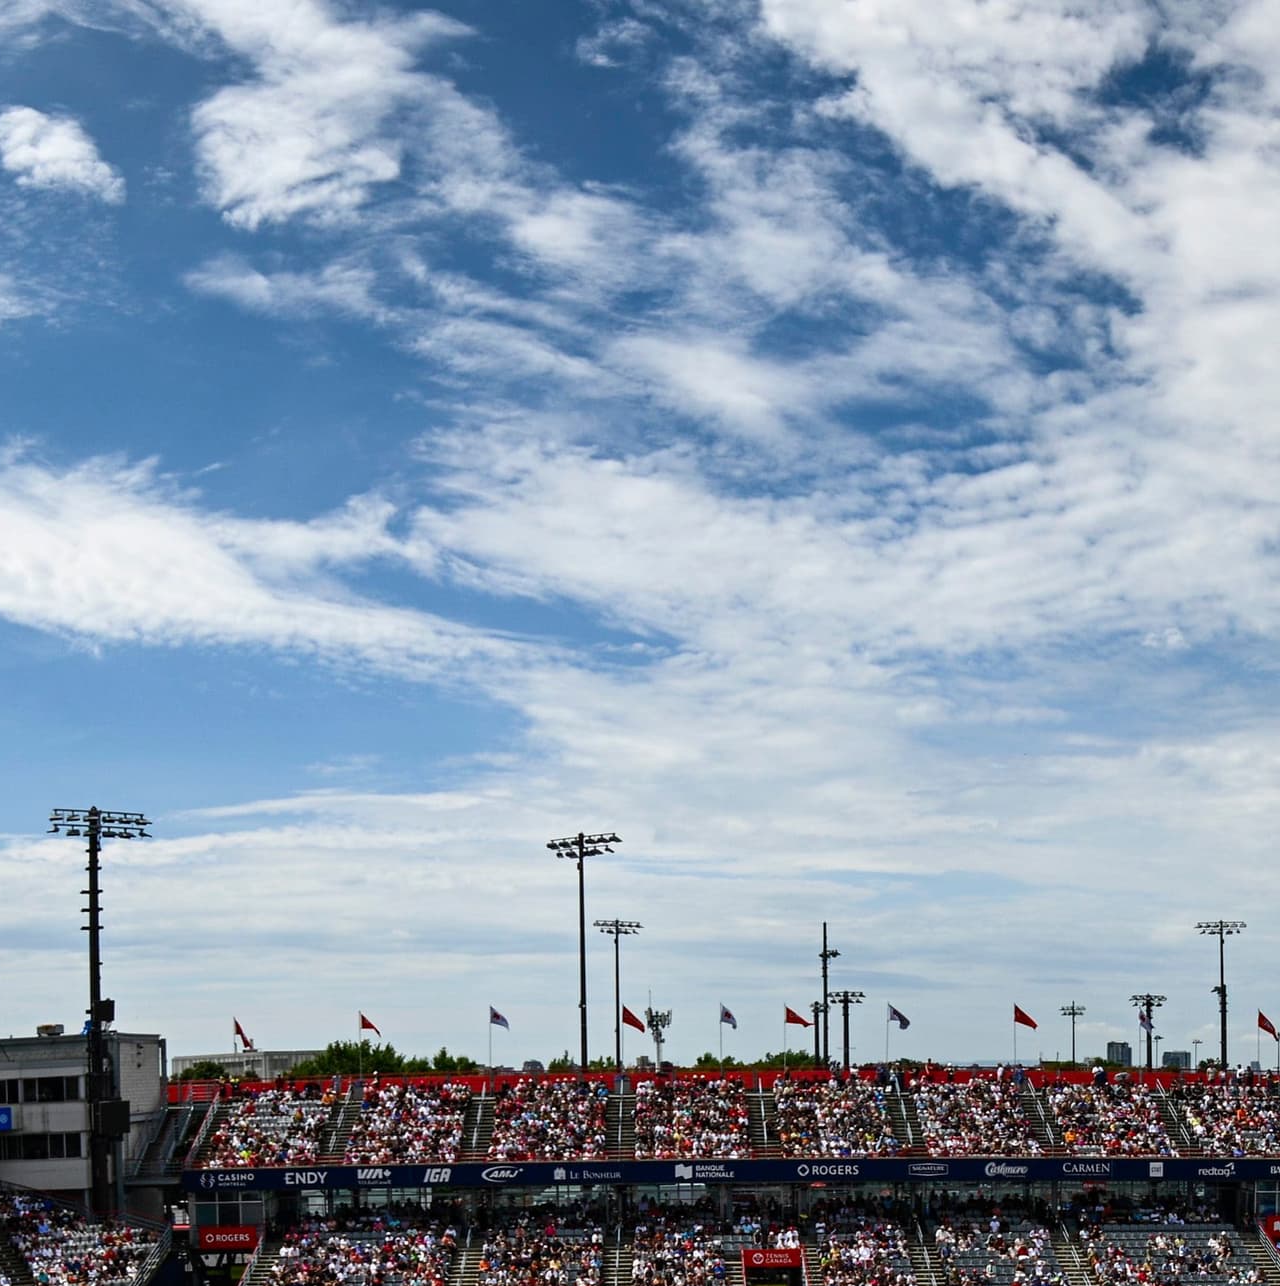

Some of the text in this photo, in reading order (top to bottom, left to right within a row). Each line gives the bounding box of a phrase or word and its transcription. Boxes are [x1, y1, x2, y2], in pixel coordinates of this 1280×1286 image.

[812, 1165, 860, 1176] ROGERS
[1062, 1162, 1111, 1173] CARMEN
[218, 1173, 255, 1182] CASINO
[284, 1172, 328, 1184] ENDY
[357, 1169, 384, 1179] VIA
[424, 1168, 452, 1183] IGA
[489, 1169, 518, 1178] AMJ
[570, 1170, 621, 1180] LE BONHEUR
[216, 1233, 250, 1242] ROGERS
